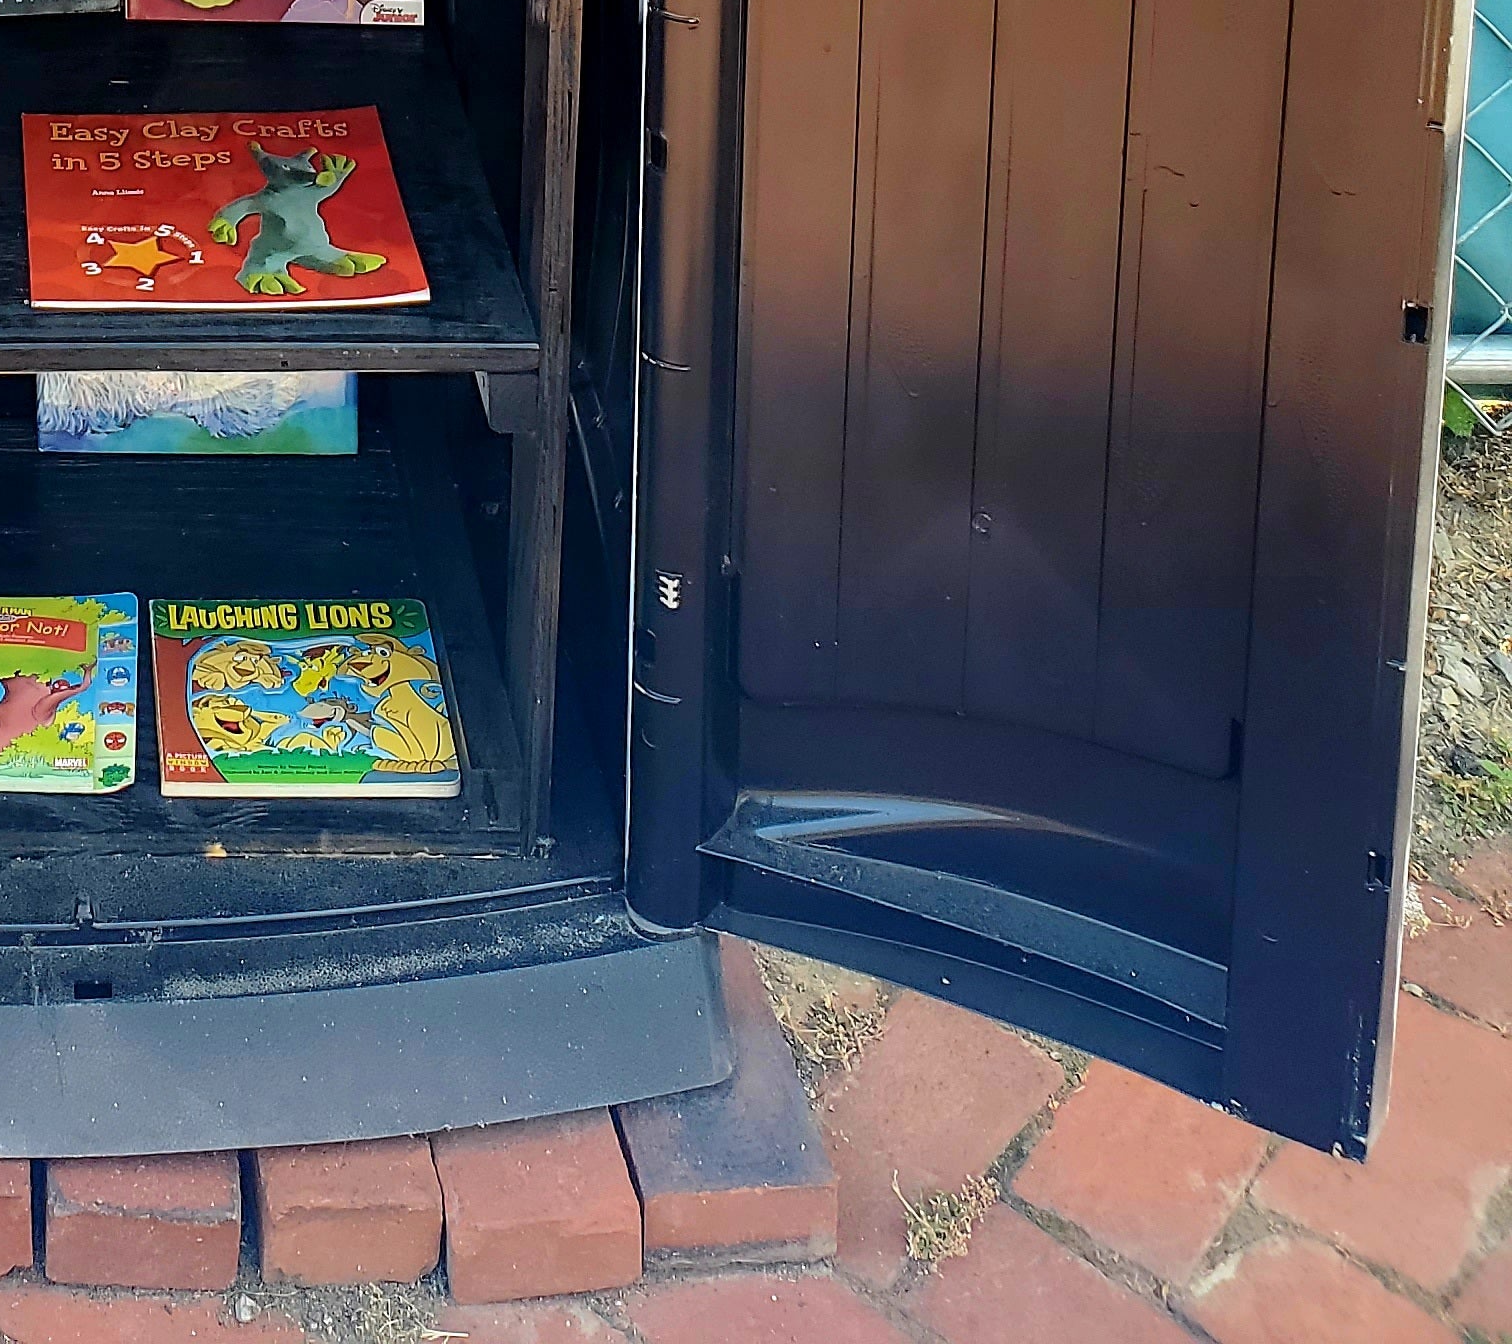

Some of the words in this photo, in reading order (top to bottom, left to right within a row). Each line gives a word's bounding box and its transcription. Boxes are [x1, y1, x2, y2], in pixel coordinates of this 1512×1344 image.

[50, 122, 131, 147] Easy
[142, 119, 220, 141] Clay
[232, 119, 349, 139] Crafts
[52, 154, 87, 171] in
[100, 152, 121, 171] 5
[133, 149, 232, 172] Steps
[168, 603, 298, 630] LAUGHING
[306, 603, 393, 629] LIONS
[0, 622, 20, 632] or
[27, 622, 69, 637] Not!
[54, 758, 87, 767] MARVEL
